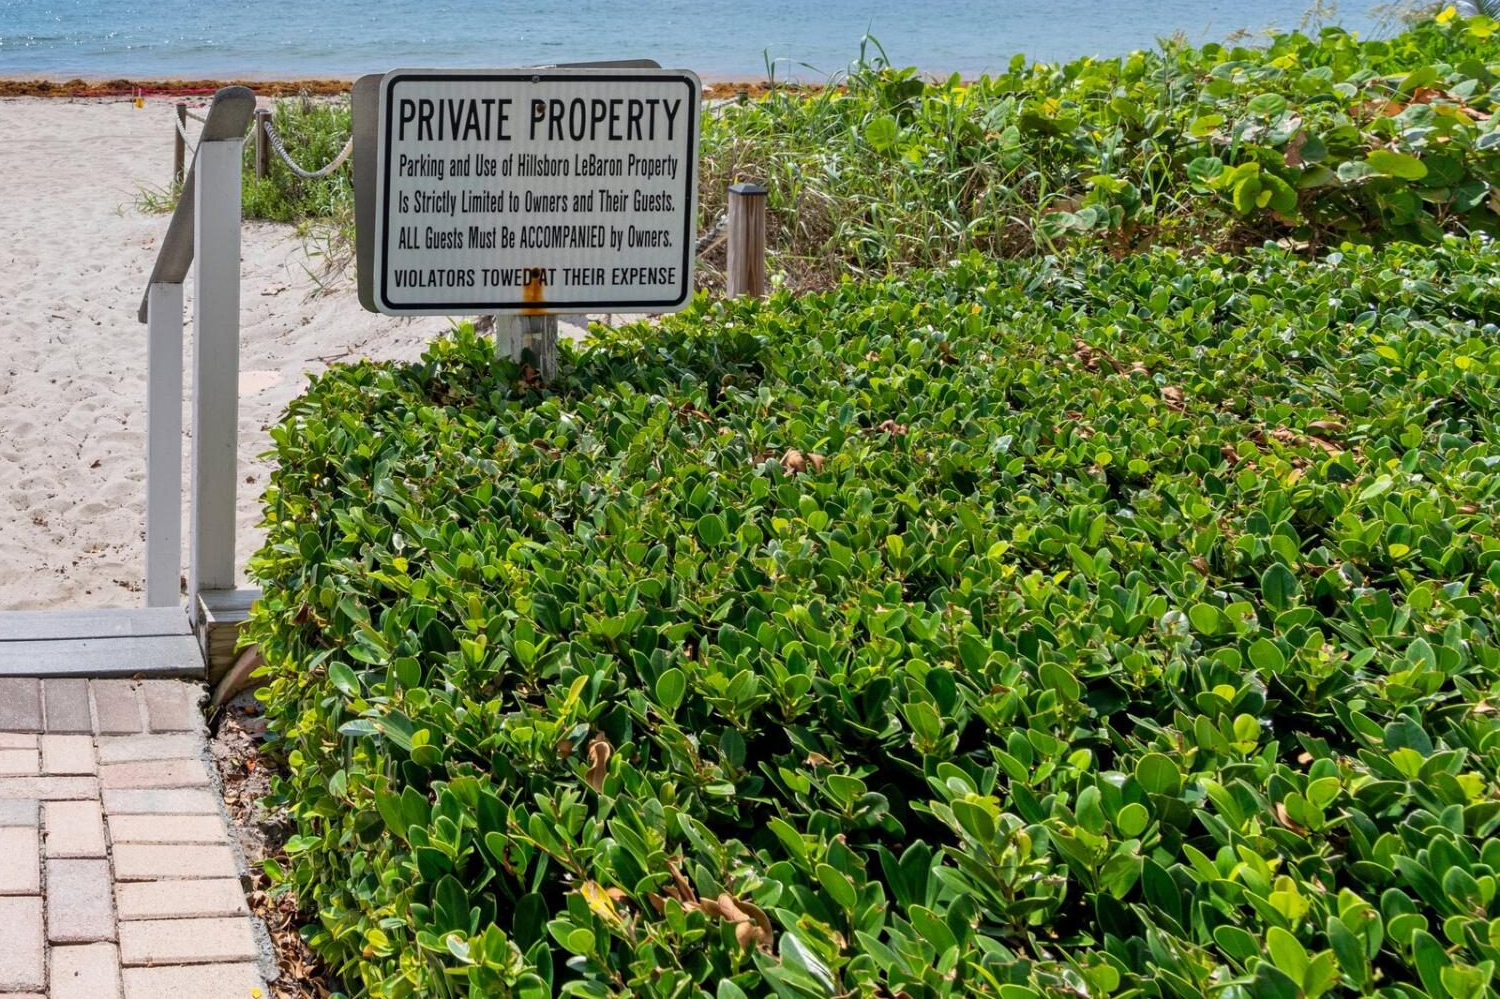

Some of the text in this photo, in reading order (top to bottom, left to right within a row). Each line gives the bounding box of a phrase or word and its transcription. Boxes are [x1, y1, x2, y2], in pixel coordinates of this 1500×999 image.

[398, 98, 682, 141] PRIVATE PROPERTY
[399, 154, 678, 180] Parking and Use of Hillsboro LeBaron Property
[399, 189, 675, 217] Is Strictly Limited to Owners and Their Guests.
[398, 225, 672, 252] ALL Guests Must Be ACCOMPANIED by Owners.
[394, 267, 676, 288] VIOLATORS TOWED AT THEIR EXPENSE
